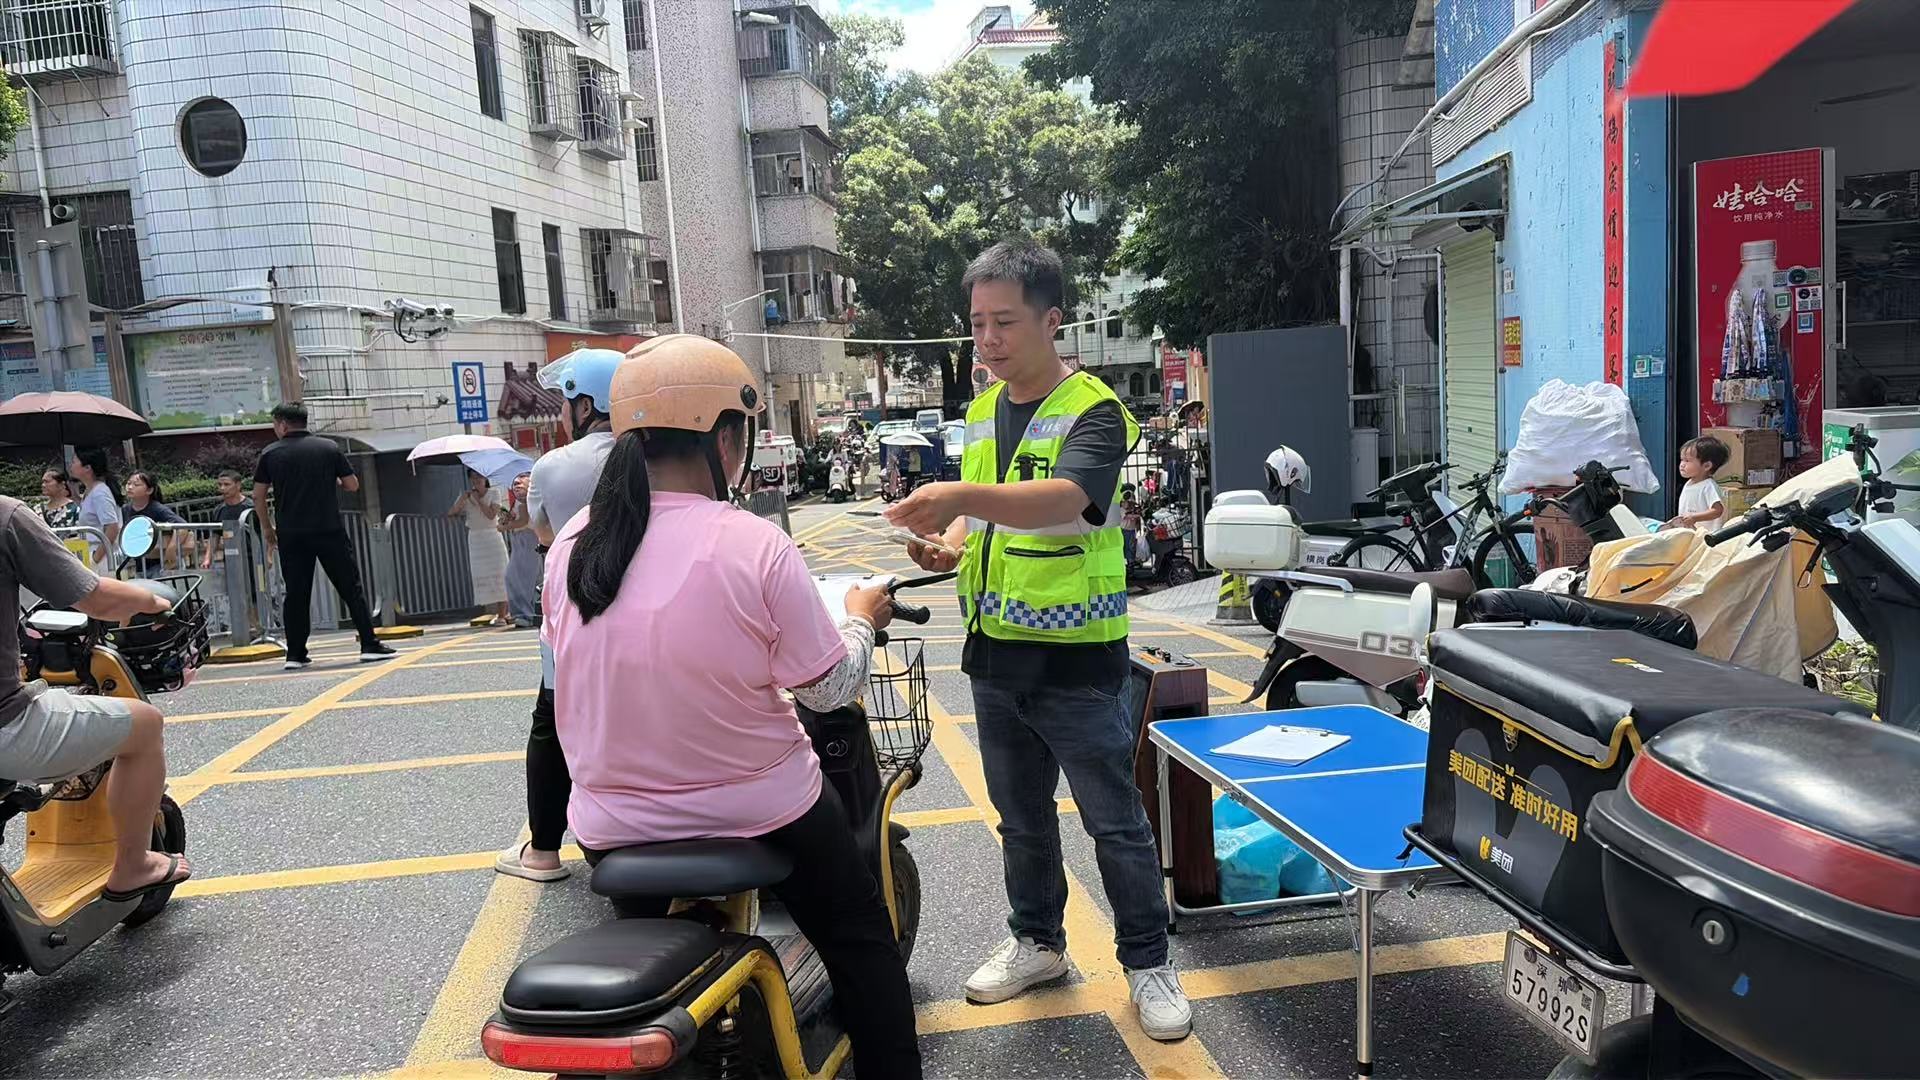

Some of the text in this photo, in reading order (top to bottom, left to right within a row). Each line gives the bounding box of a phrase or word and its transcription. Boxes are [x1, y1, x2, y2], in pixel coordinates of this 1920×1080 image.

[1713, 178, 1804, 211] 娃哈哈
[1733, 210, 1784, 223] 饮用纯净水
[1448, 750, 1579, 842] 美团配送 准时好用
[1490, 846, 1514, 874] 美团
[1512, 968, 1588, 1042] 57992S
